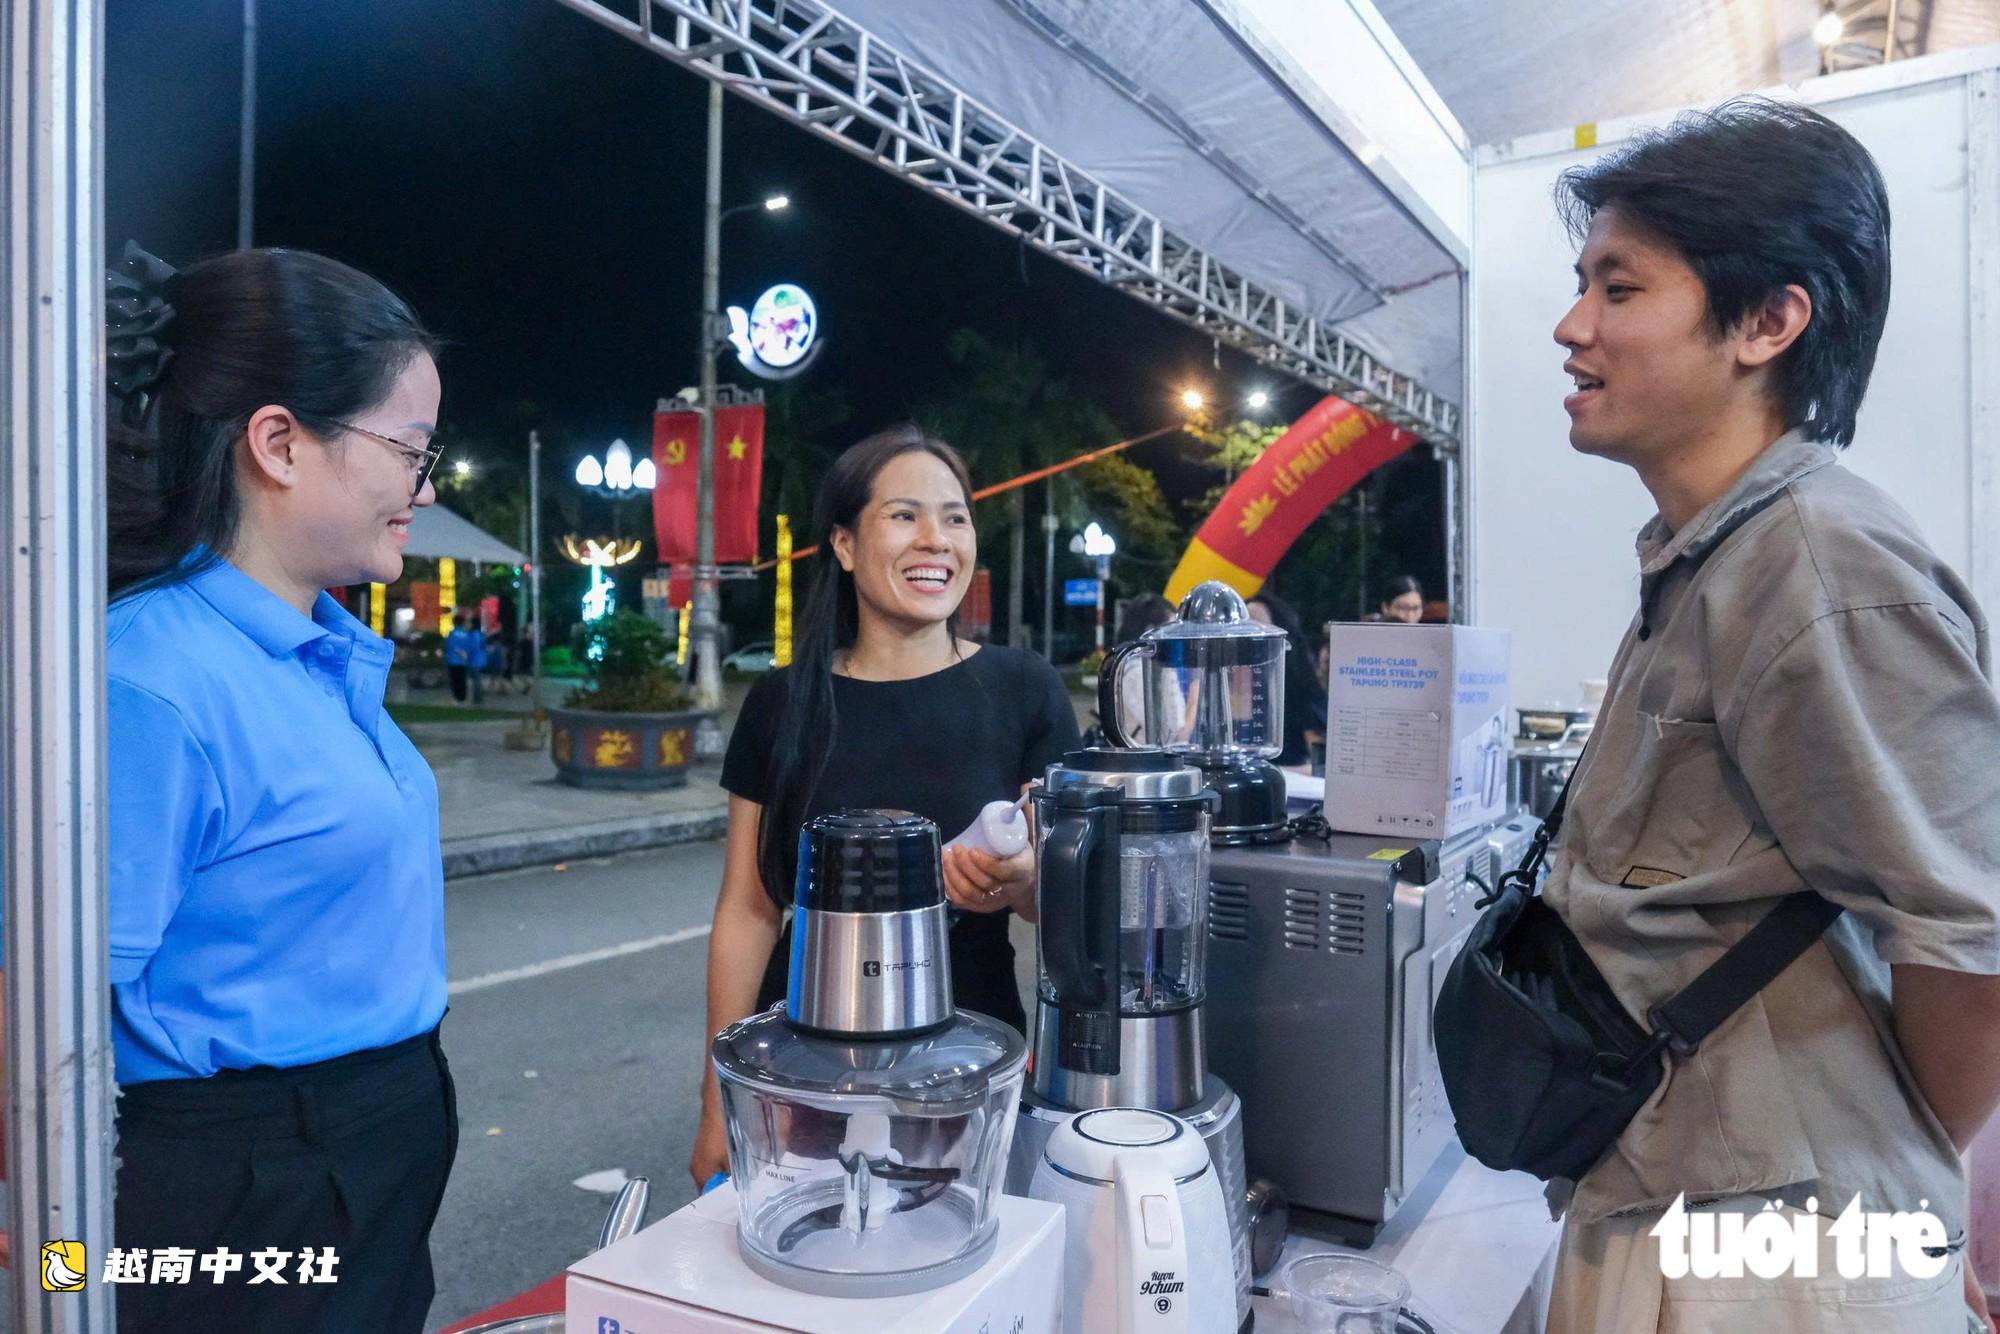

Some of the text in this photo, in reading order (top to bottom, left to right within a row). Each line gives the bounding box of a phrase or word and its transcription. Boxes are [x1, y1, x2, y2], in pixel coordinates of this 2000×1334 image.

[1356, 656, 1418, 667] HIGH-CLASS
[1339, 666, 1440, 680] STAINLESS STEEL POT
[1350, 677, 1389, 688] TAPUHO
[765, 1169, 795, 1183] MAX LINE
[1139, 1280, 1184, 1295] 9chum
